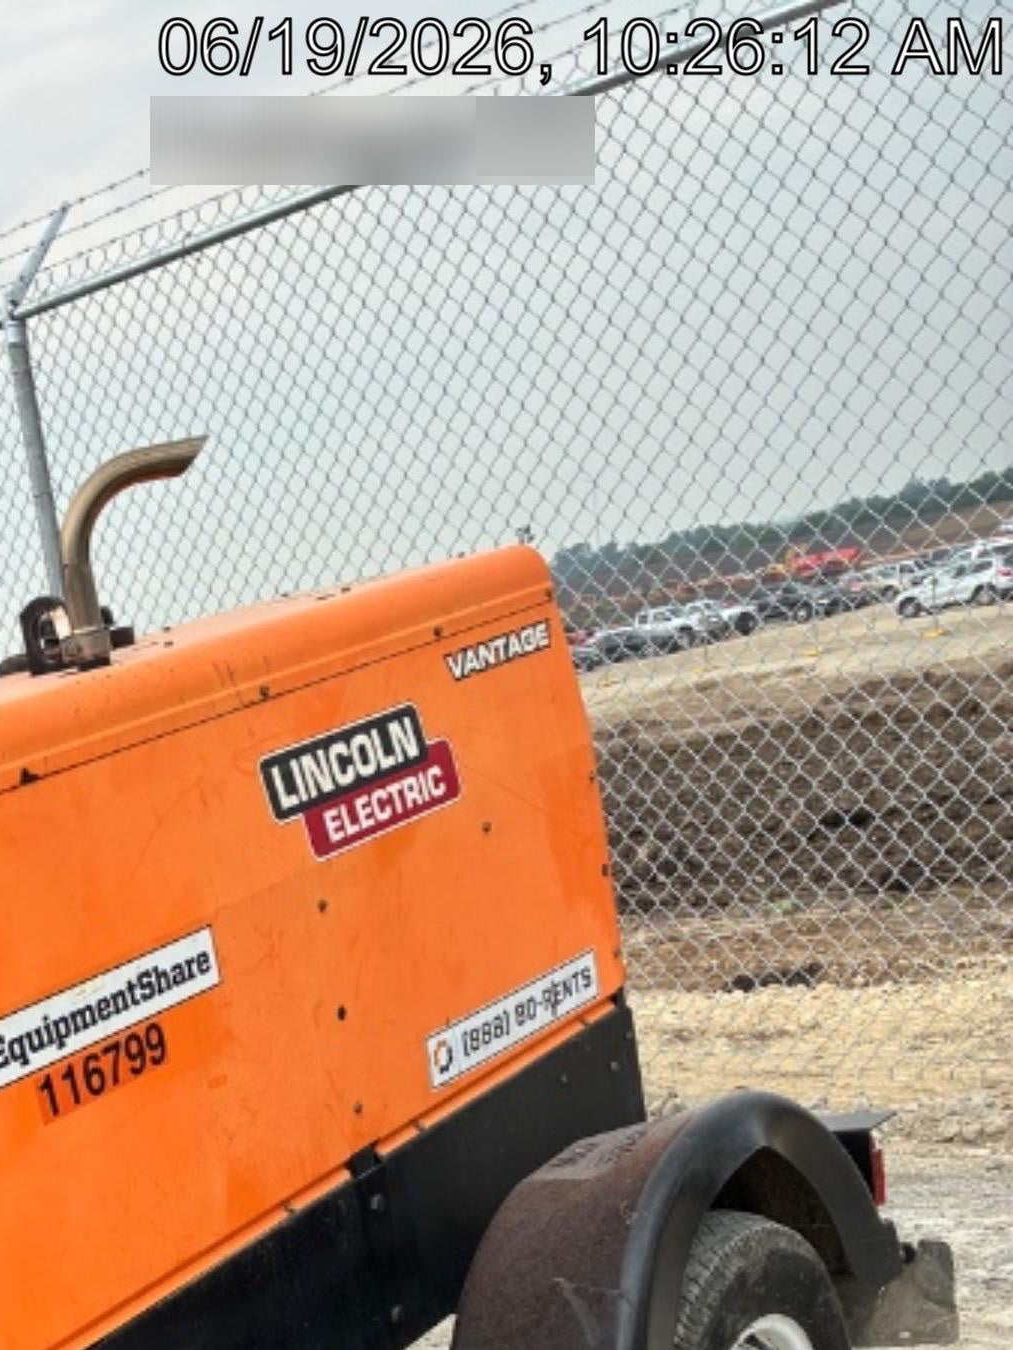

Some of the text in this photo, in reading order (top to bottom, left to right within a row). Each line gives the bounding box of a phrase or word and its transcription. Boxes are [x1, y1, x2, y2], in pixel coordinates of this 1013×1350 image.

[443, 619, 550, 681] VANTAGE
[269, 715, 421, 811] LINCOLN
[323, 765, 447, 844] ELECTRIC
[461, 965, 592, 1057] (888) 80-RENTS
[39, 1022, 167, 1117] 116799
